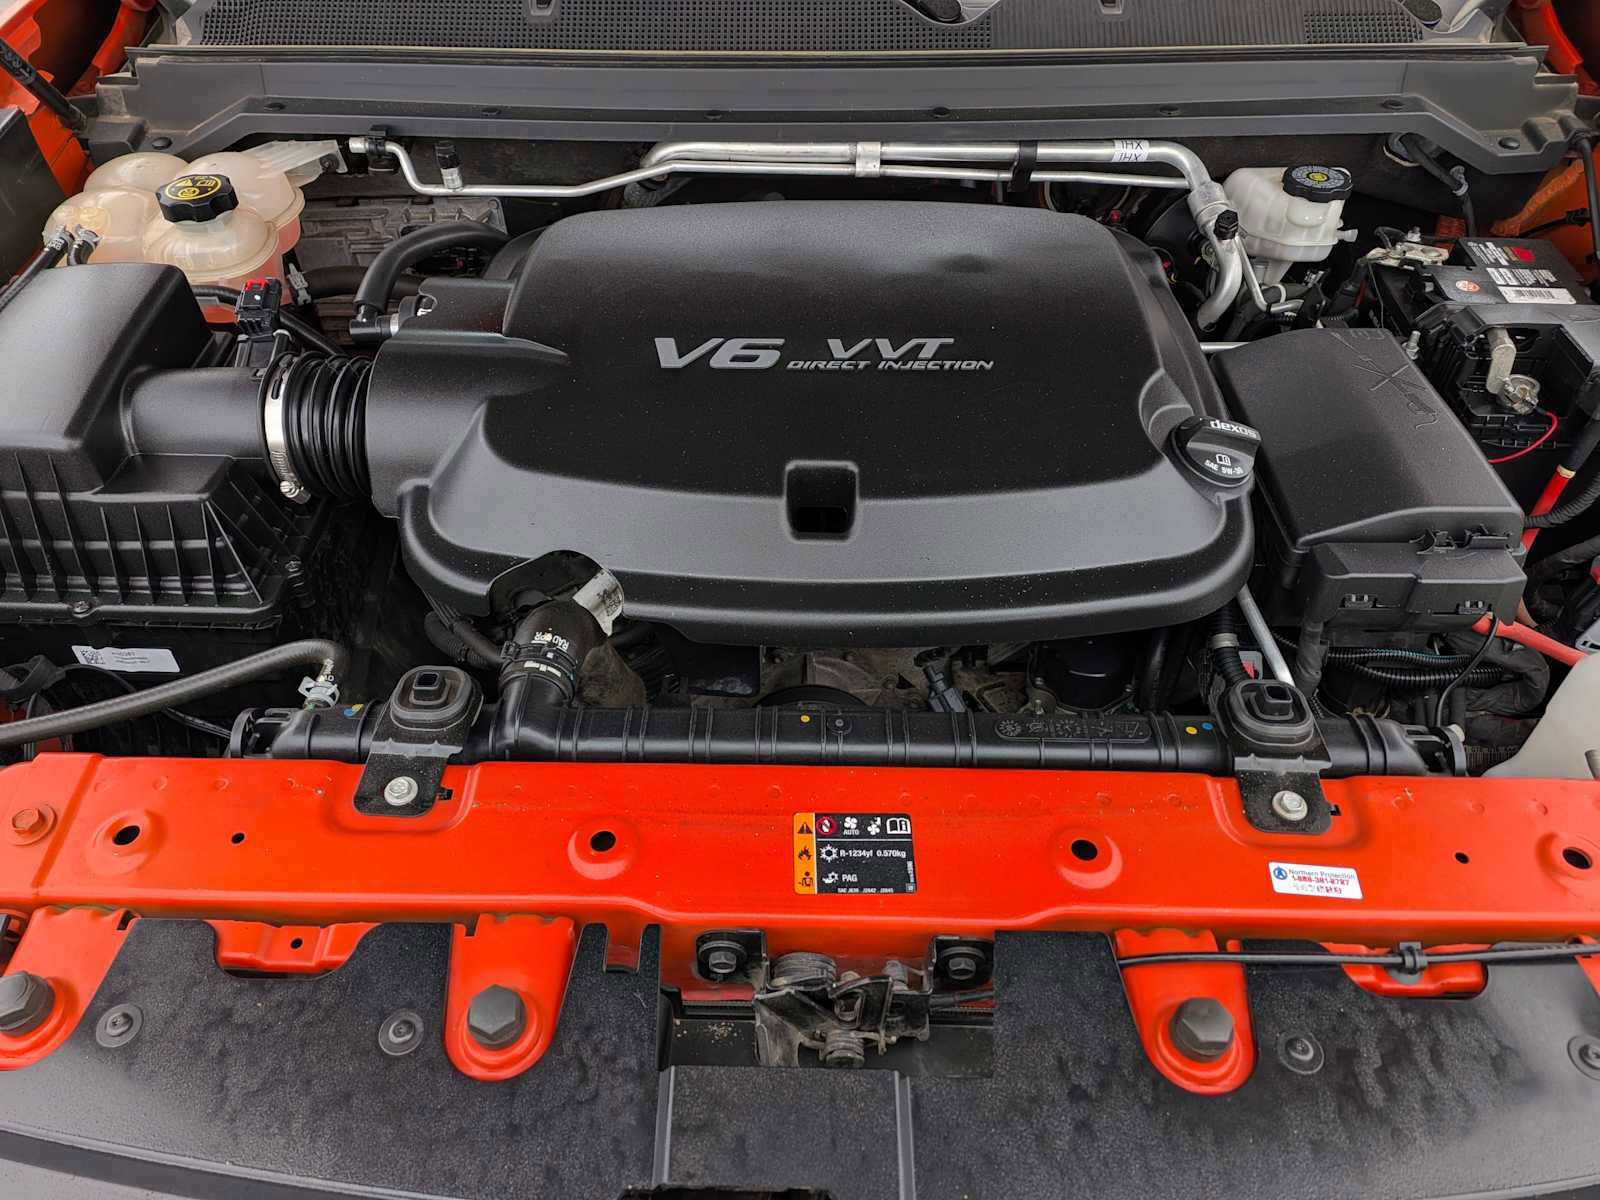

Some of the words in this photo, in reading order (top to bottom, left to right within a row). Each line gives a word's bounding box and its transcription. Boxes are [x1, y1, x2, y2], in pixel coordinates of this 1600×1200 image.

[654, 337, 786, 369] V6
[826, 338, 955, 359] VVT
[786, 360, 871, 371] DIRECT
[877, 360, 995, 371] INJECTION
[1210, 419, 1257, 439] dexos
[534, 631, 553, 642] PR
[552, 635, 570, 650] RAD
[876, 850, 906, 858] 0.570kg
[842, 874, 858, 882] PAG
